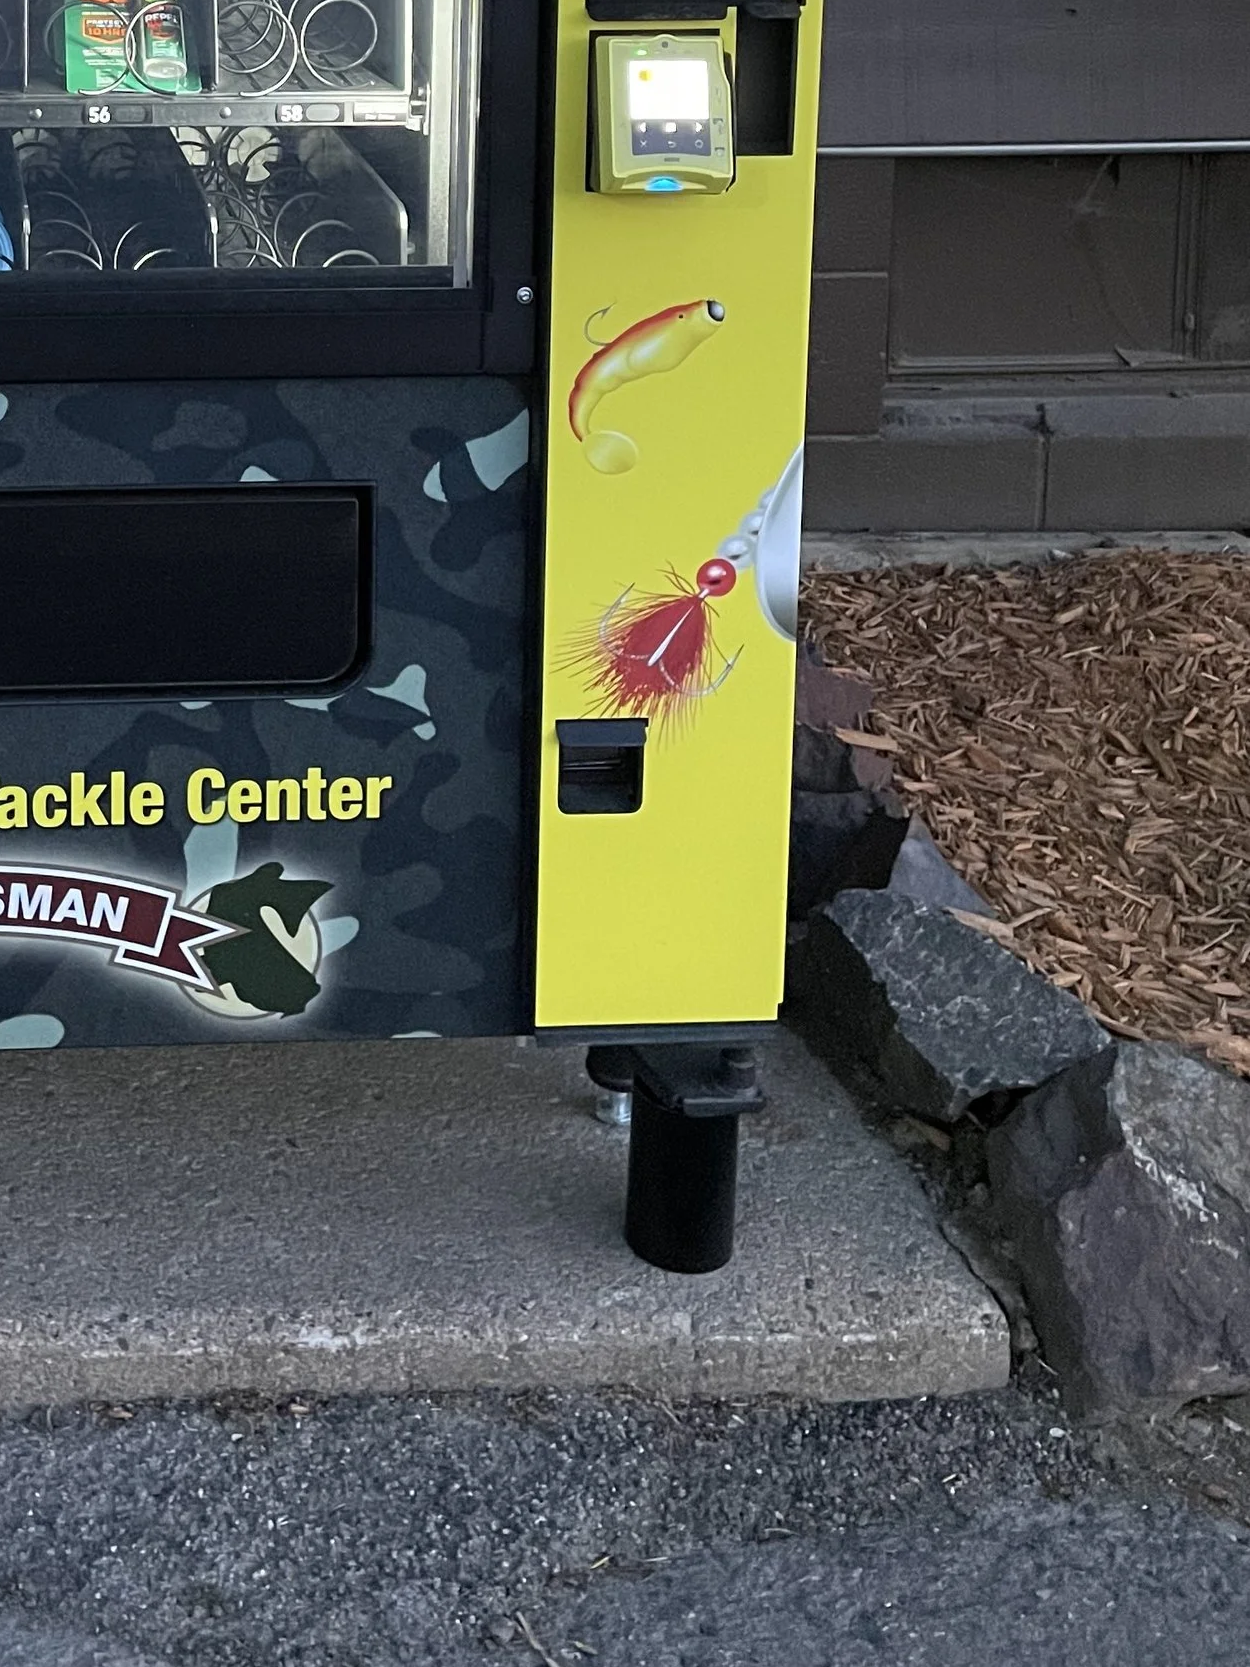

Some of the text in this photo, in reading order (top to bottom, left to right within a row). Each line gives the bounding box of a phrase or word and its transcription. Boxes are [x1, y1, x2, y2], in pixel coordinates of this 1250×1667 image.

[88, 106, 111, 124] 56
[280, 105, 303, 122] 58
[186, 766, 392, 825] Center
